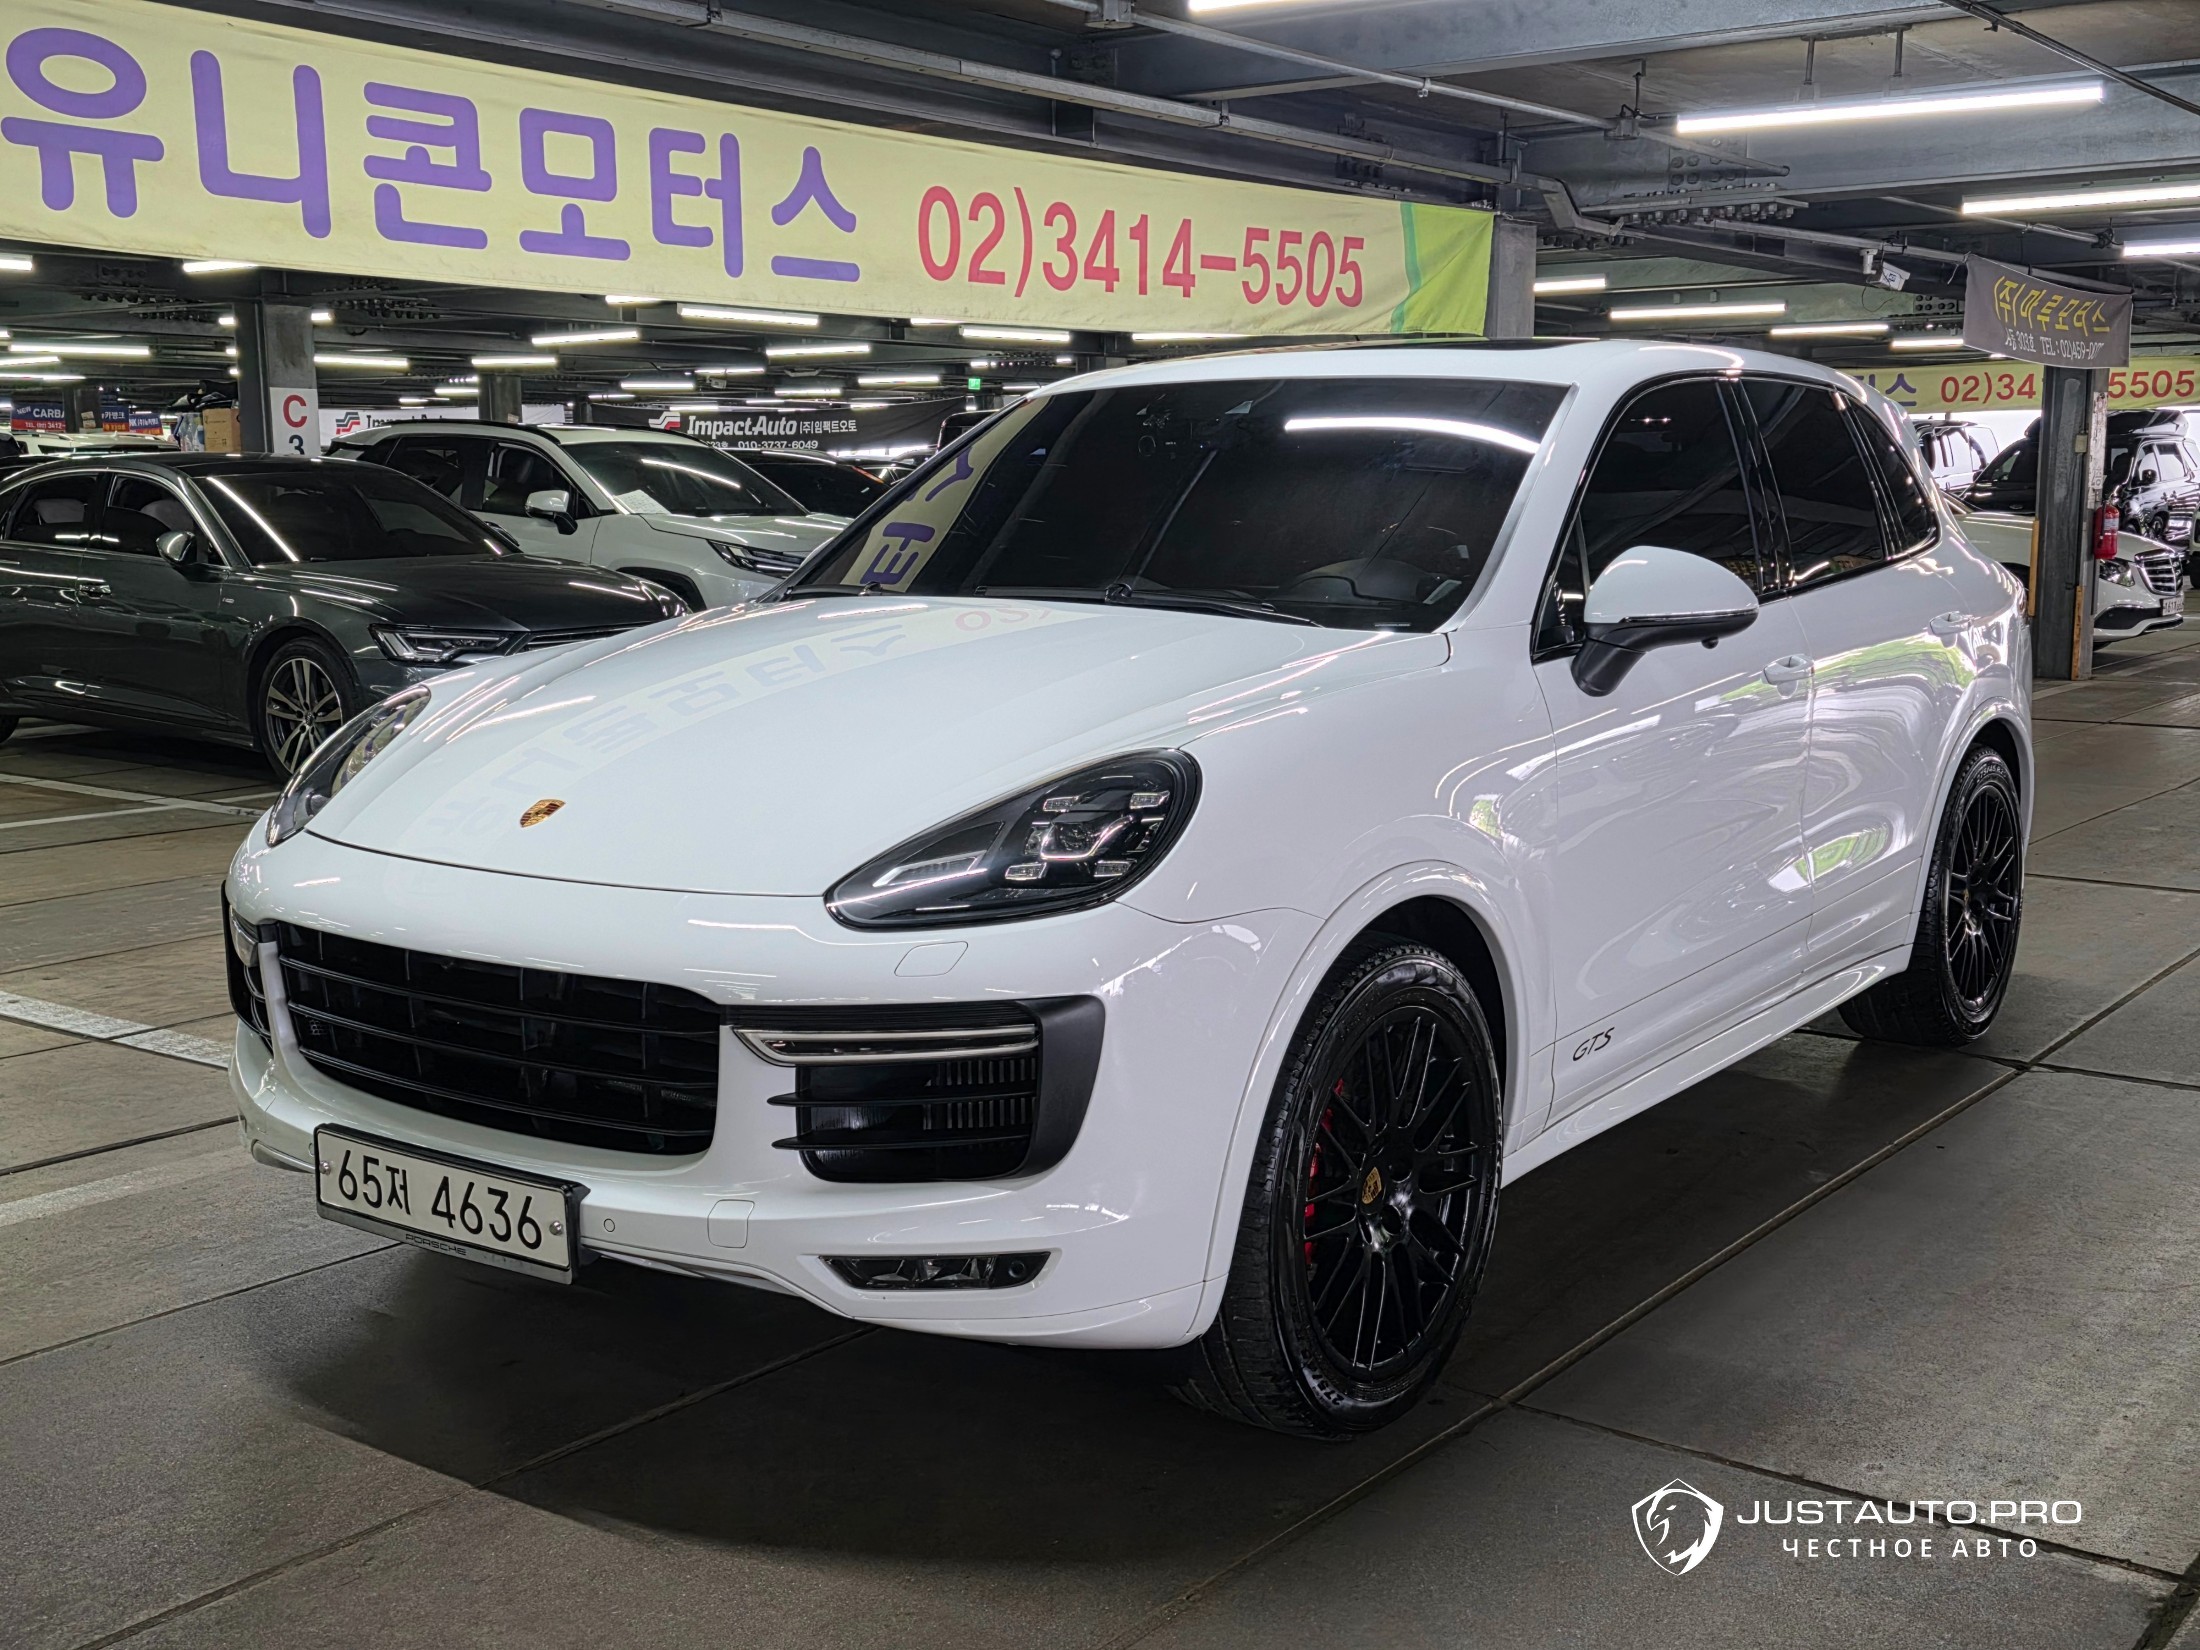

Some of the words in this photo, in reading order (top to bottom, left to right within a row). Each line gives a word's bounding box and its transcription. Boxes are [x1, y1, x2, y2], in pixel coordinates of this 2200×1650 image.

[1, 27, 860, 282] 유니콘모터스
[917, 185, 1365, 307] 02)3414-5505
[282, 394, 308, 428] C
[687, 415, 797, 440] ImpactAuto
[288, 434, 306, 455] 3
[738, 440, 818, 449] 010-3737-6049
[1572, 1026, 1615, 1061] GTS
[338, 1149, 411, 1215] 65저
[431, 1176, 542, 1250] 4636
[406, 1233, 467, 1256] PORSCHE
